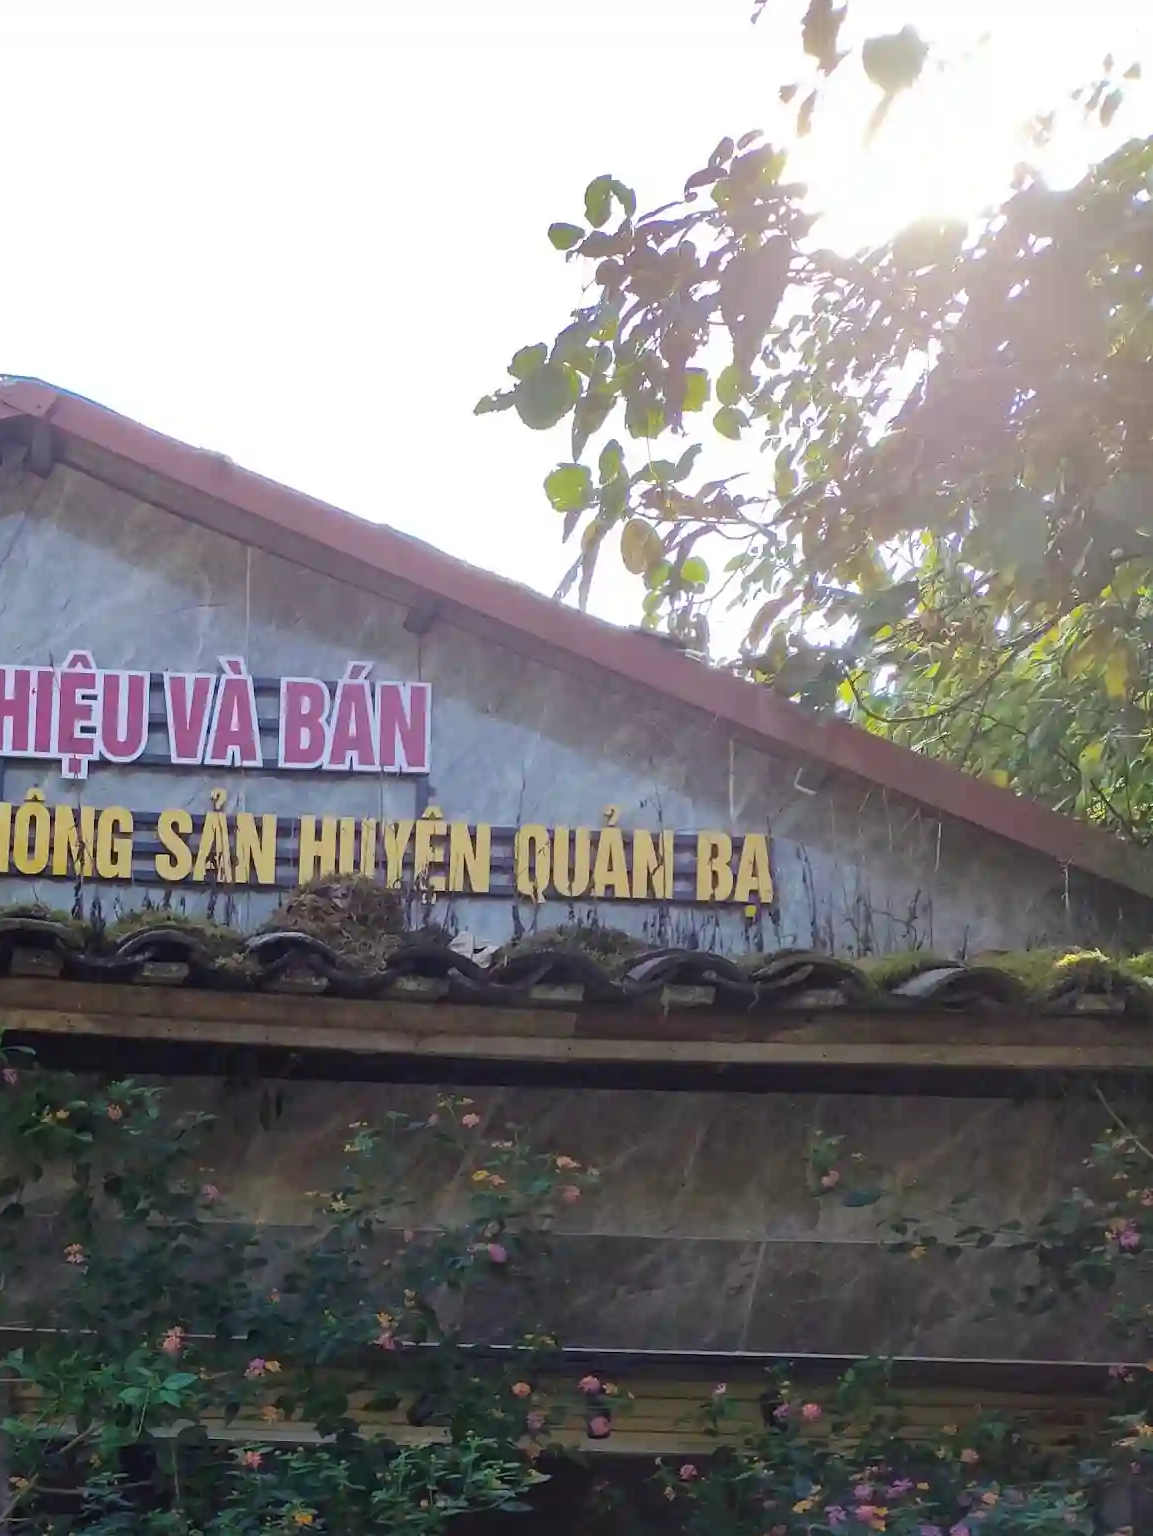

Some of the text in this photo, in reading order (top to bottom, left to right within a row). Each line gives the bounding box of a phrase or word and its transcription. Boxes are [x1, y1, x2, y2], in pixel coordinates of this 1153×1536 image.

[164, 655, 261, 768] VÀ
[278, 660, 432, 773] BÁN
[155, 787, 277, 884] SẢN
[299, 805, 492, 904] HUYỆN
[514, 804, 674, 903] QUẢN
[696, 829, 774, 918] BẠ
